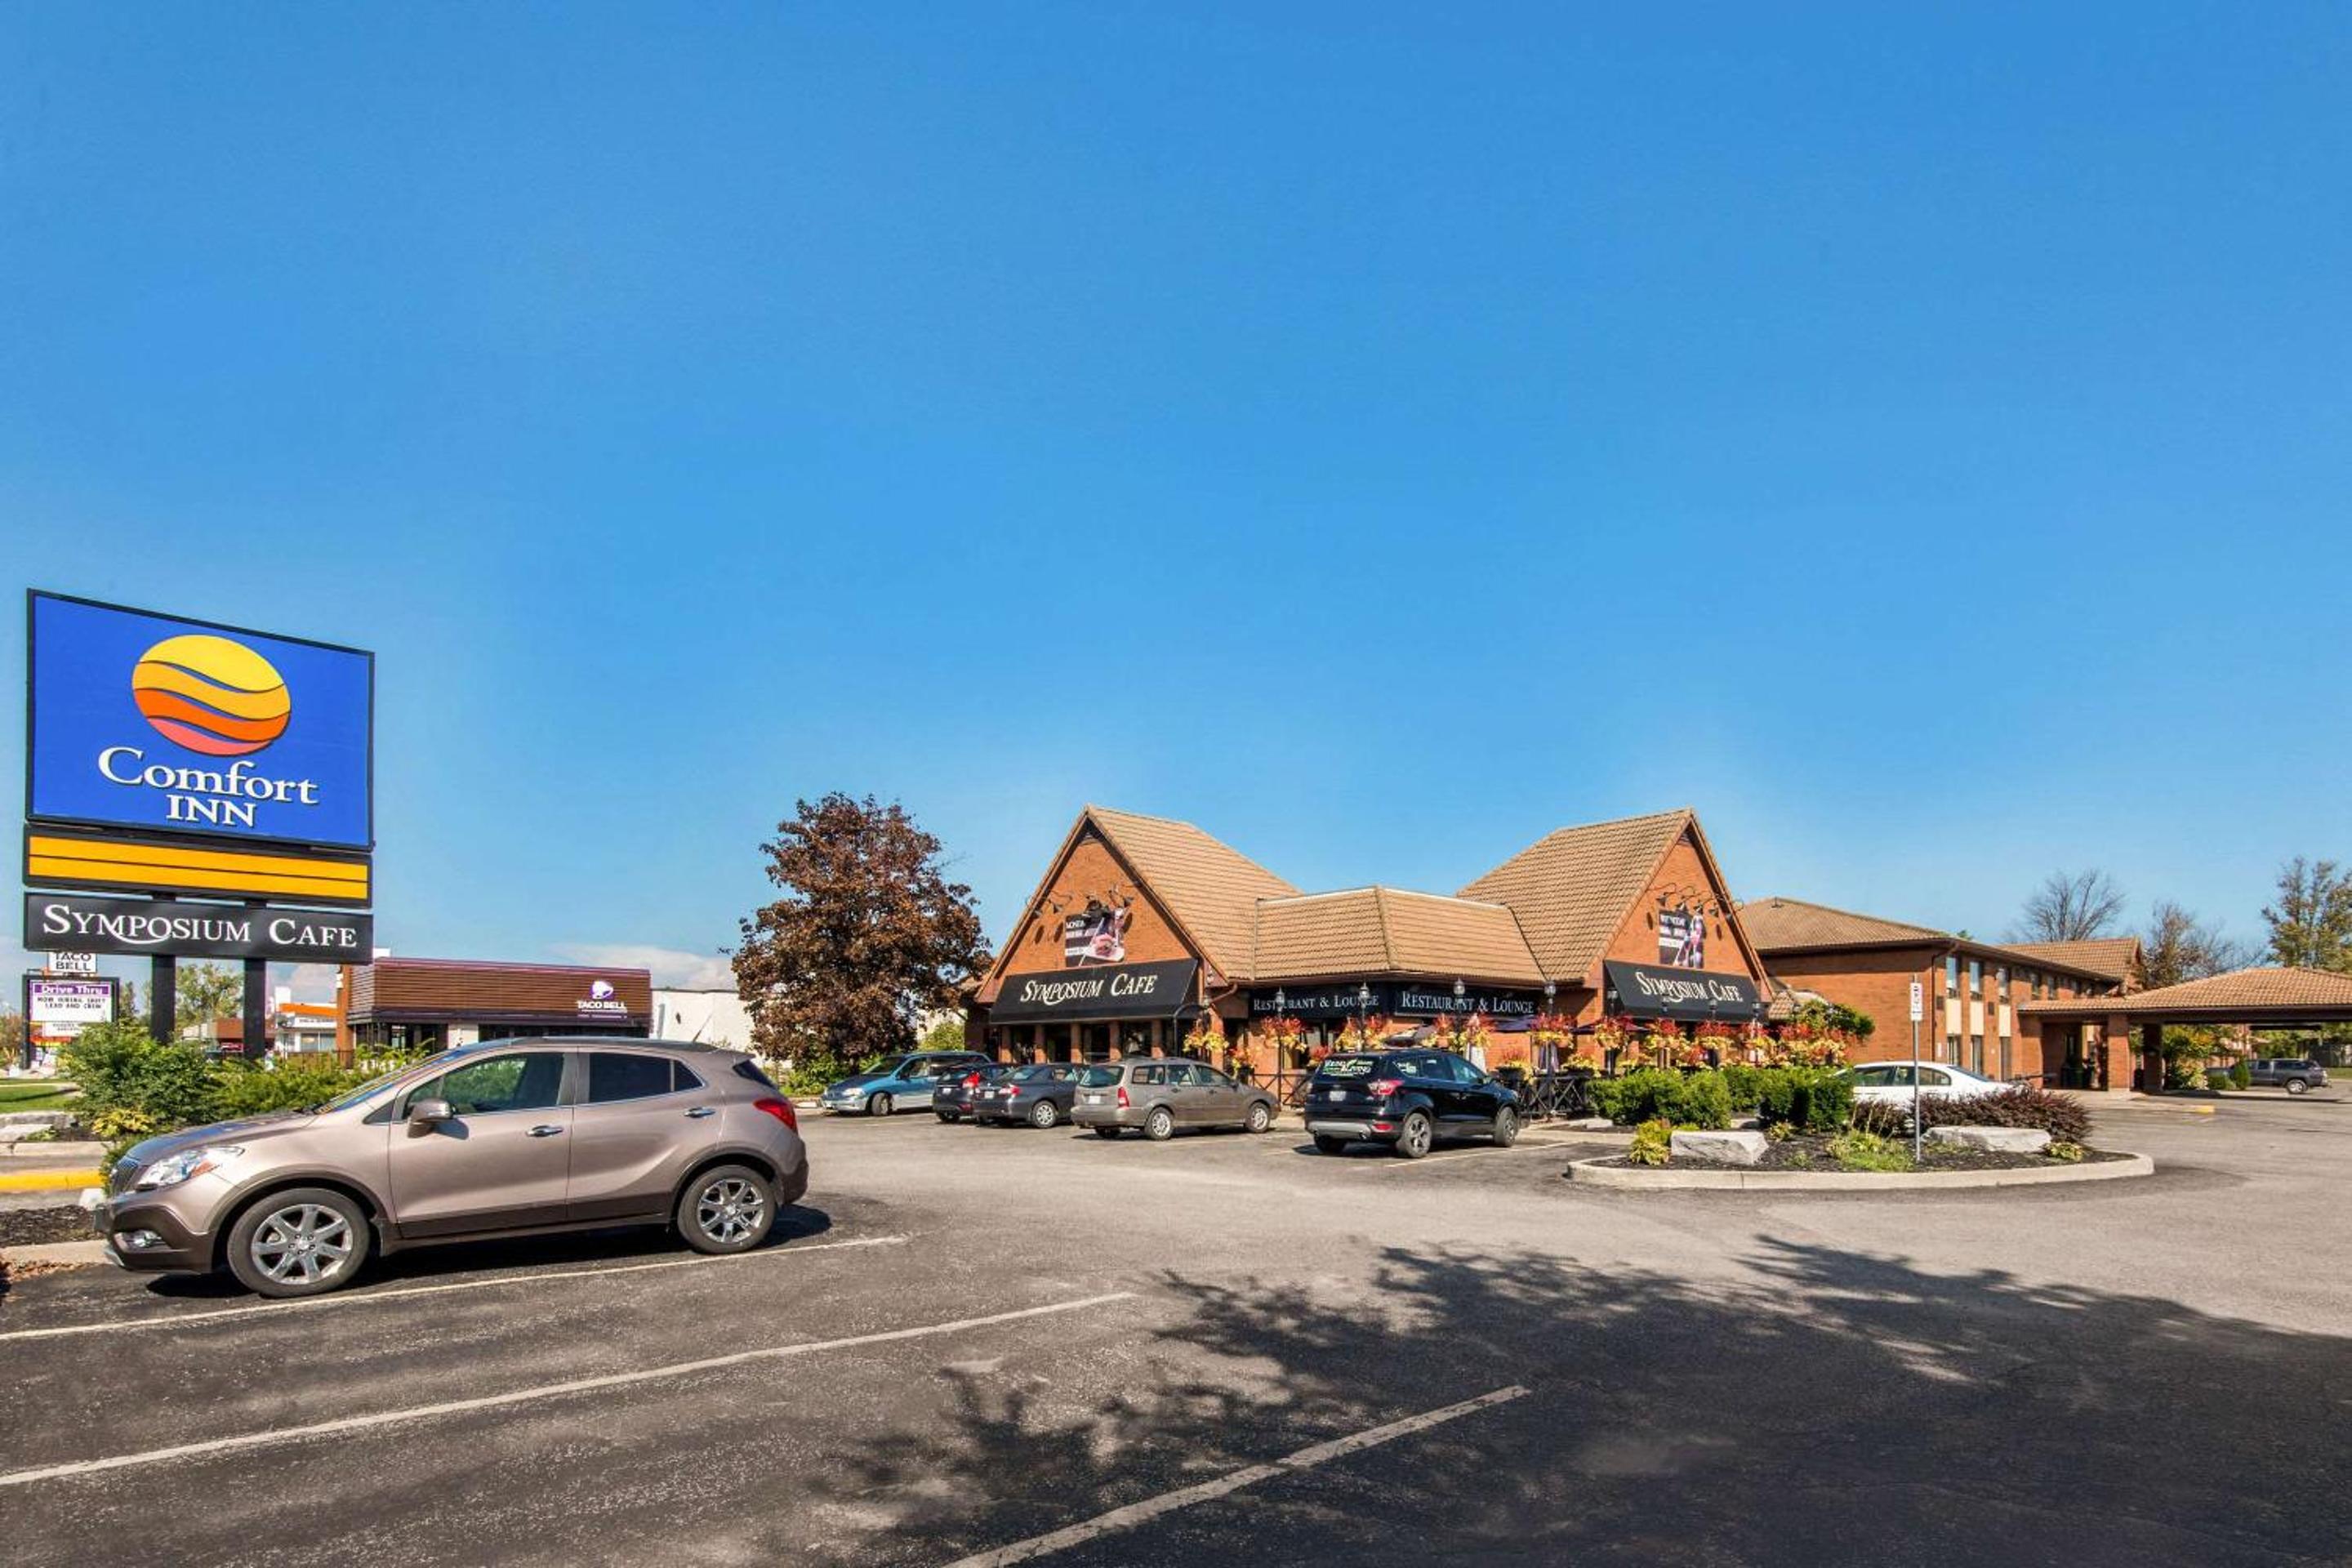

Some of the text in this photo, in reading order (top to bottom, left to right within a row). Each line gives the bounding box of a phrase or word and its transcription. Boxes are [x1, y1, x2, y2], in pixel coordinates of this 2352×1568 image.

[98, 746, 318, 804] Comfort
[166, 794, 256, 827] INN
[43, 903, 358, 948] SYMPOSIUM CAFE
[56, 952, 91, 962] TACO
[56, 961, 91, 971] BELL
[1020, 973, 1158, 1006] SYMPOSIUM CAFE
[1635, 972, 1744, 1003] SYMPOSIUM CAFE
[576, 1000, 626, 1009] TACO BELL
[1254, 997, 1316, 1011] RESTURANT
[1320, 996, 1330, 1008] &
[1478, 997, 1489, 1012] &
[1493, 996, 1535, 1013] LOUNGE
